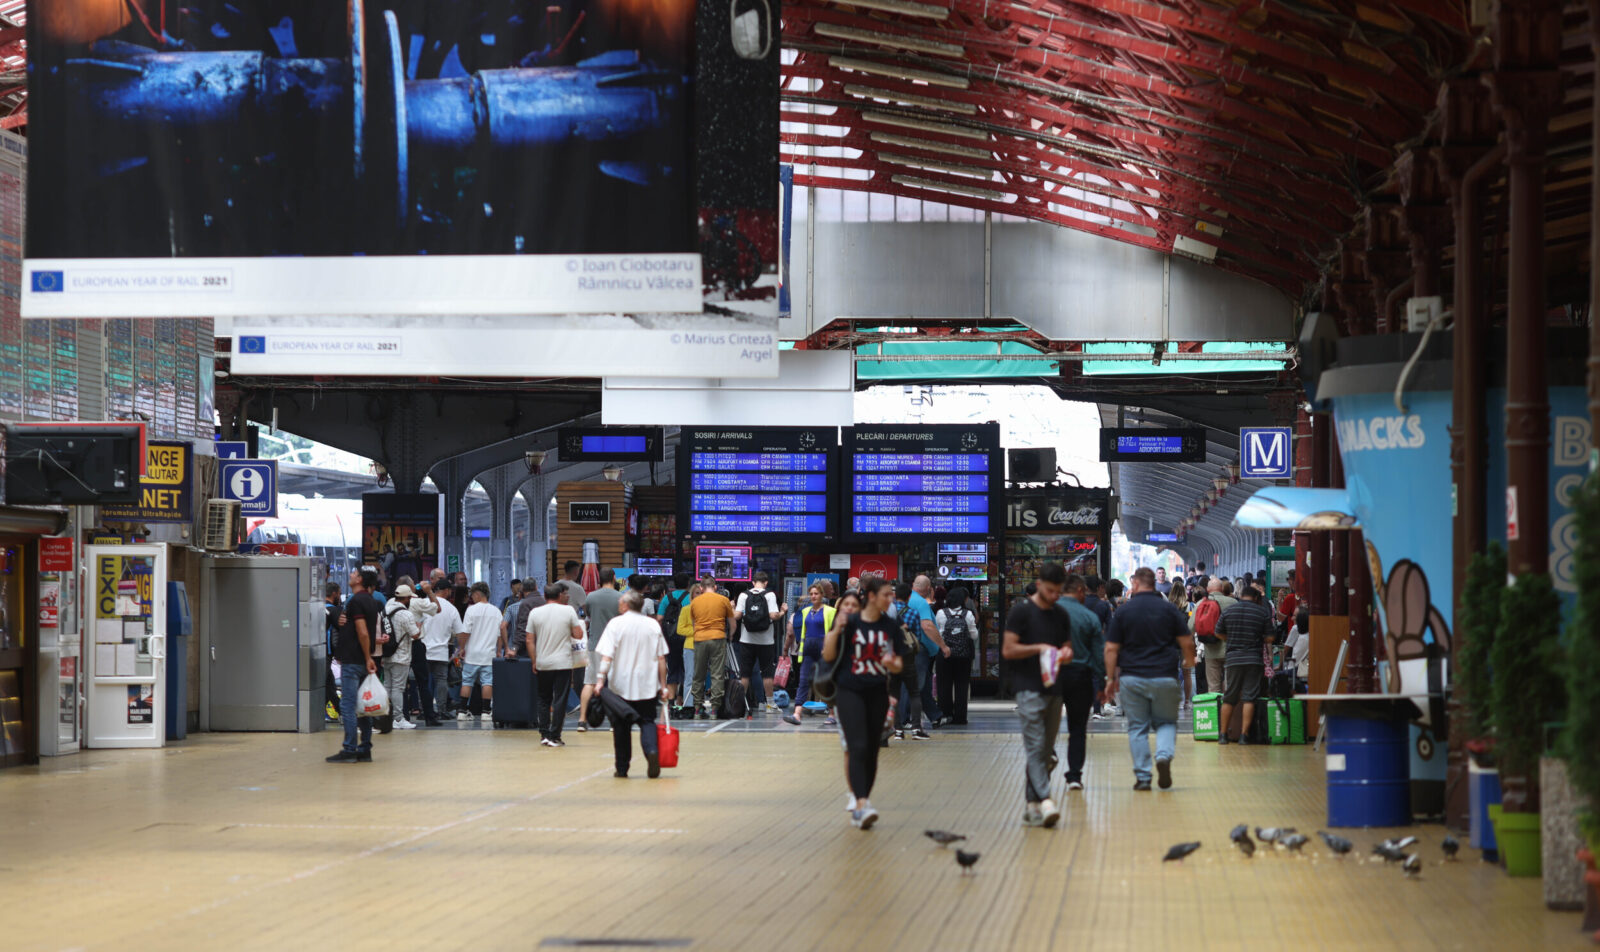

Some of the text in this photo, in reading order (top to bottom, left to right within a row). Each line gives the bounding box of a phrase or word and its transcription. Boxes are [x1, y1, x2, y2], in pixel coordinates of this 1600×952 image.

[582, 259, 616, 272] Ioan
[620, 258, 694, 272] Ciobotaru
[72, 276, 228, 286] EUROPEAN YEAR OF RAIL 2021
[578, 276, 694, 290] Râmnicu Vâlcea
[684, 334, 725, 344] Marius
[728, 333, 772, 344] Cinteză
[272, 342, 318, 350] EUROPEAN
[320, 342, 341, 350] YEAR
[342, 342, 354, 350] OF
[357, 342, 375, 350] RAIL
[648, 438, 653, 449] 7
[1250, 433, 1282, 466] M
[139, 488, 182, 509] NET
[1007, 504, 1038, 528] lis
[1196, 710, 1209, 720] Bolt
[1196, 720, 1212, 730] Food
